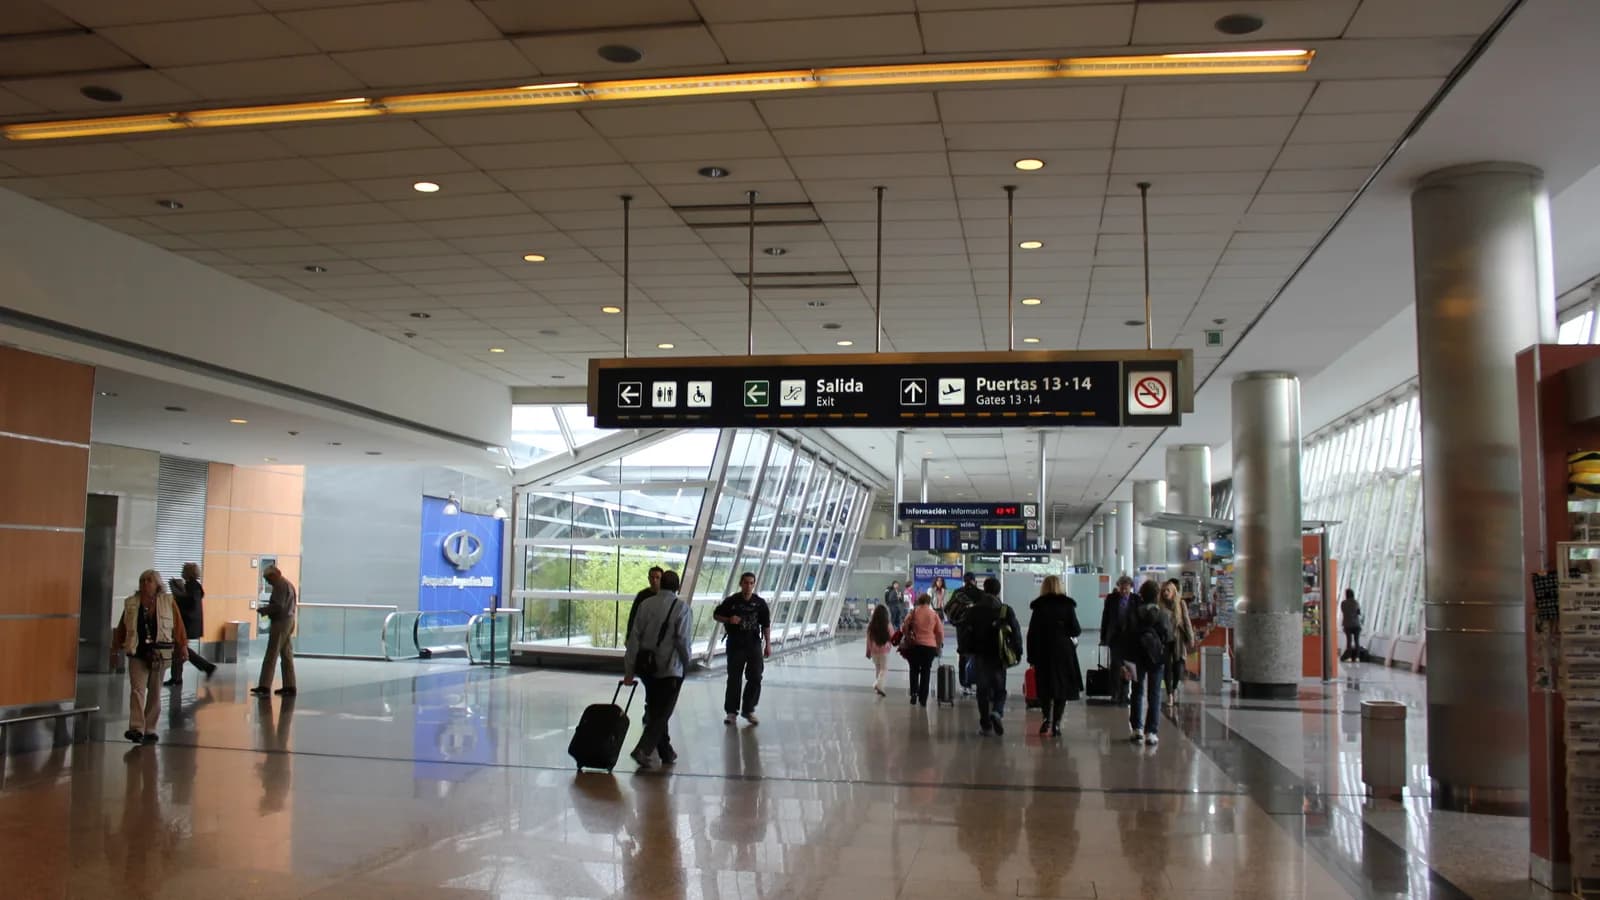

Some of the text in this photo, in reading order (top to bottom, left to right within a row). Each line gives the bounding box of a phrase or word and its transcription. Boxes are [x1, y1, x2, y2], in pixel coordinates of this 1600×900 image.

[816, 379, 864, 393] Salida
[976, 377, 1038, 391] Puertas
[817, 396, 835, 407] Exit
[976, 395, 1006, 405] Gates
[905, 507, 989, 516] Información Information
